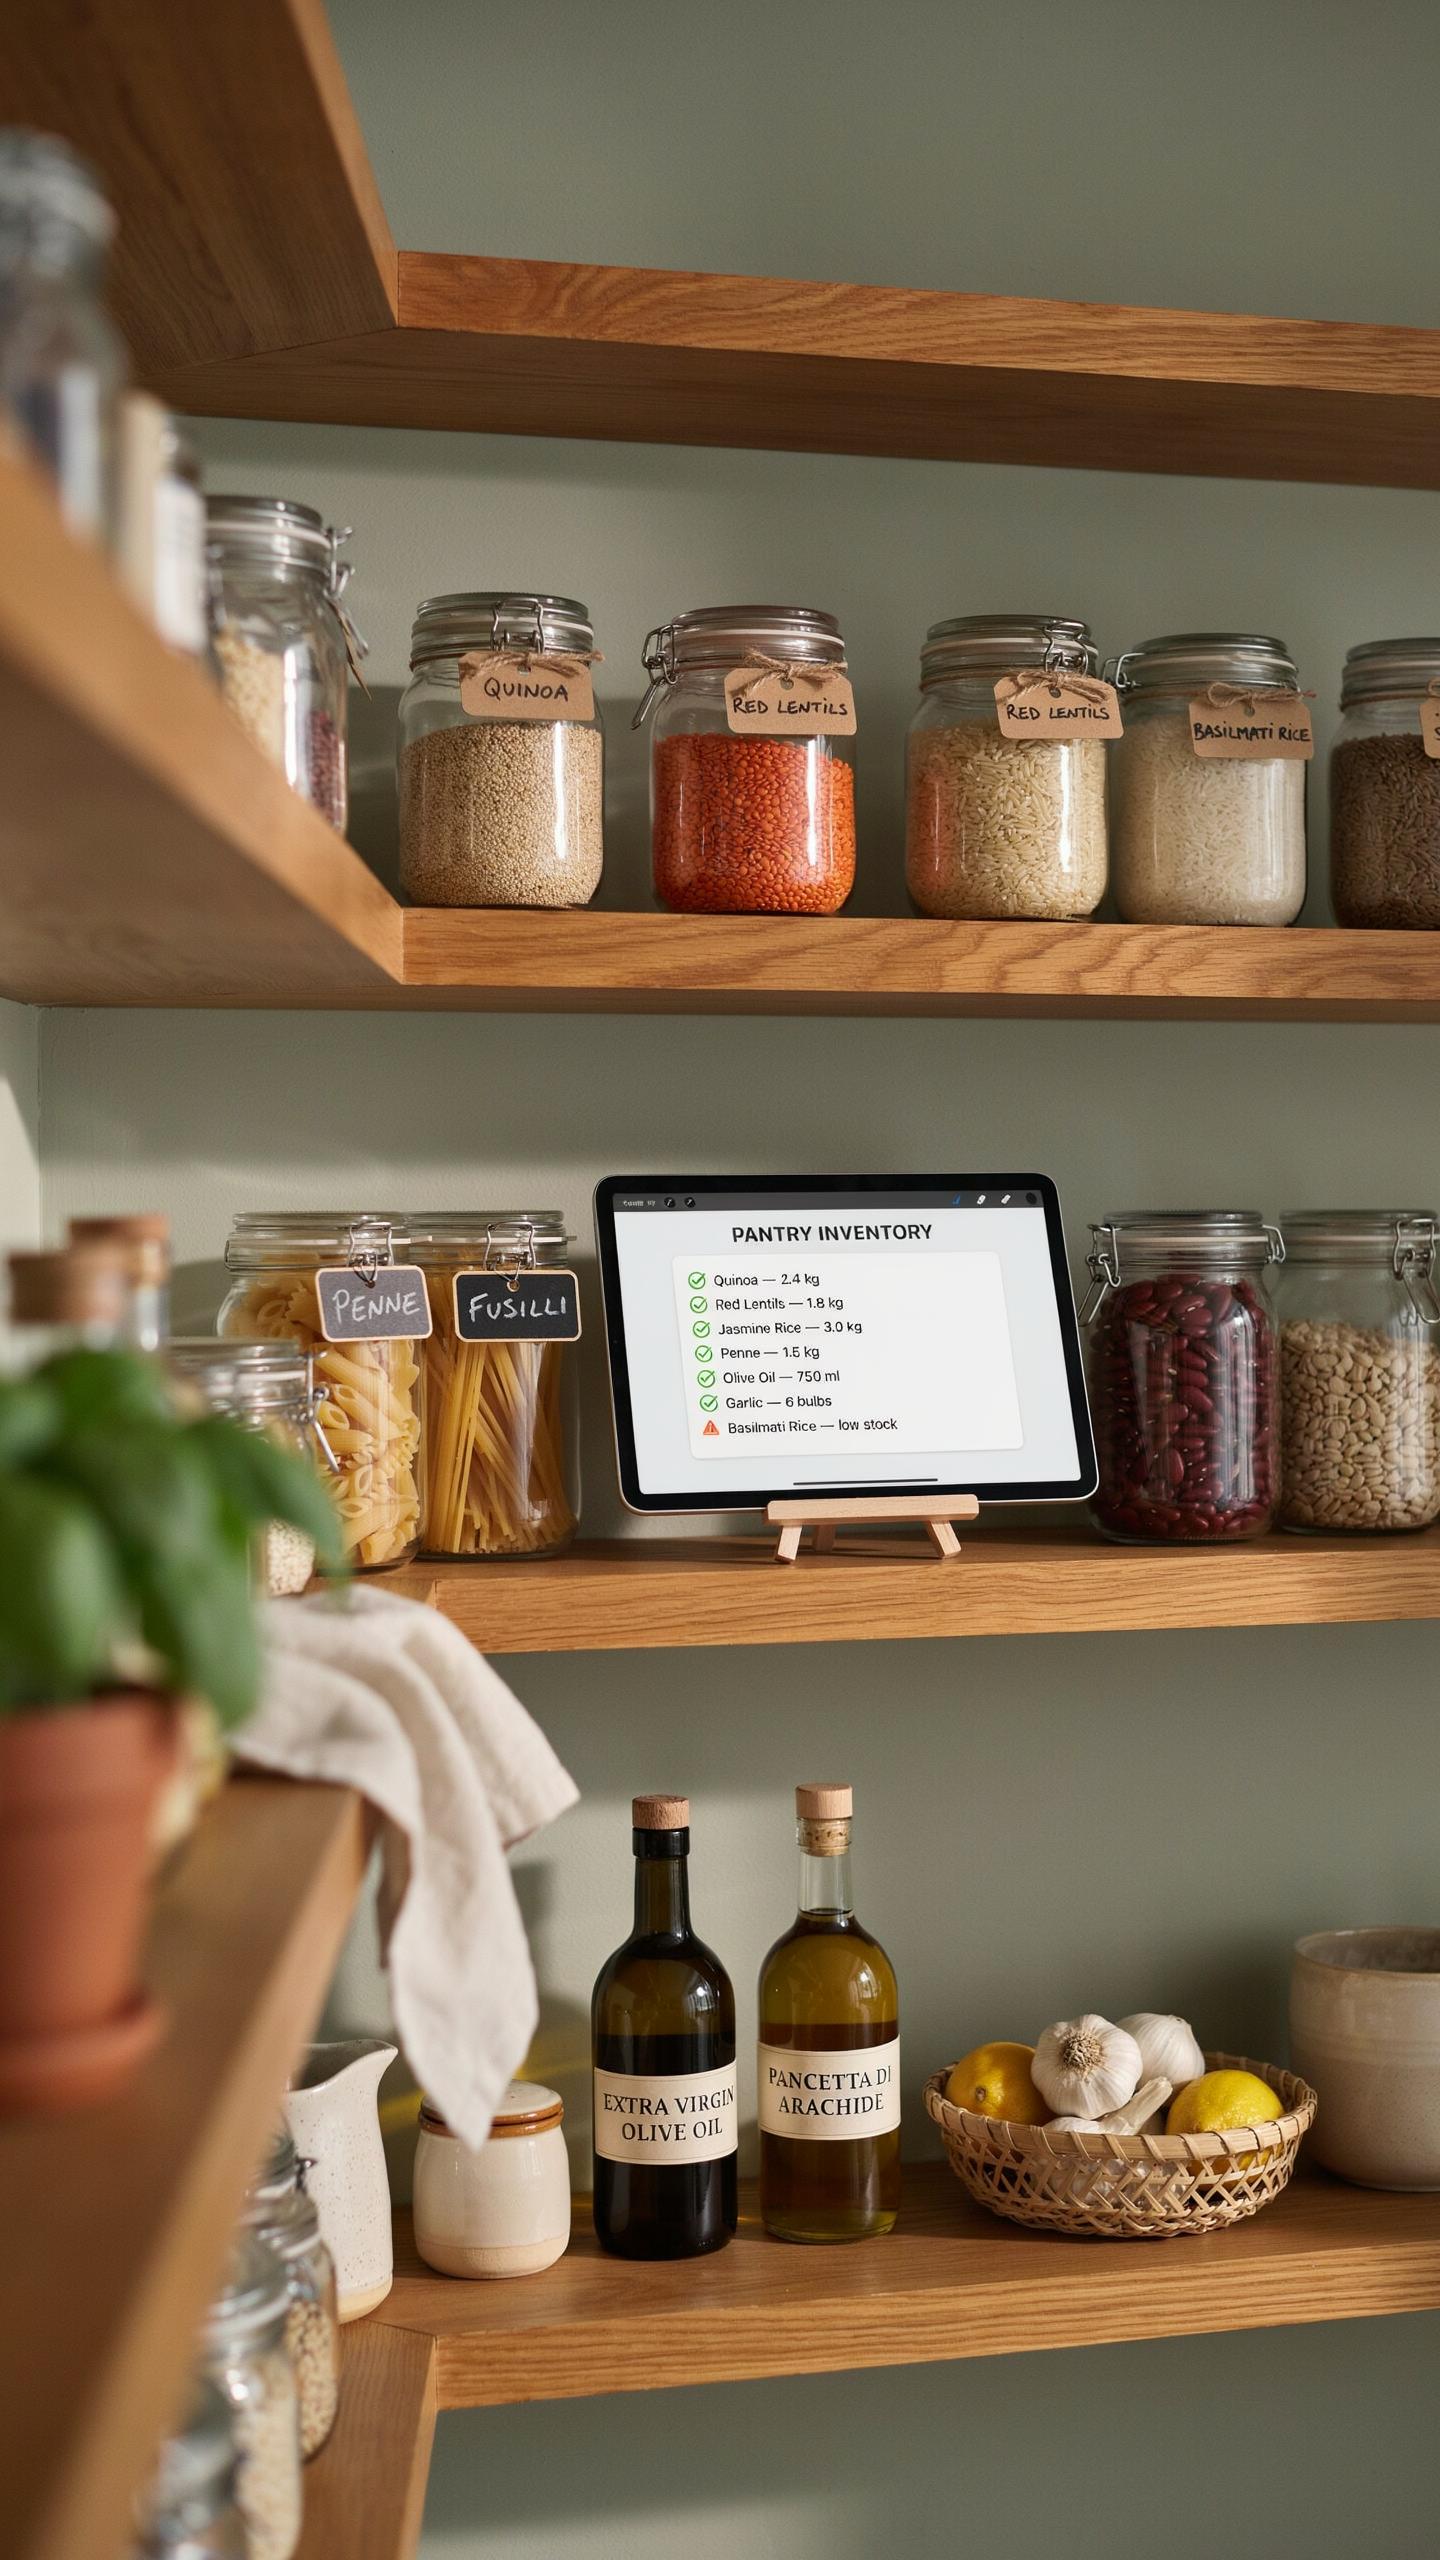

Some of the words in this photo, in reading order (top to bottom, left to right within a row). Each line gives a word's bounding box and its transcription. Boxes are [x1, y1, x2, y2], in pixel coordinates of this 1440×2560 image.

[484, 677, 569, 702] QUINOA
[733, 697, 768, 714] RED
[1006, 703, 1040, 720] RED
[732, 1226, 812, 1243] PANTRY
[819, 1224, 933, 1242] INVENTORY
[714, 1274, 758, 1287] Quinoa
[781, 1274, 801, 1285] 2.4
[805, 1273, 820, 1287] kg
[332, 1289, 421, 1324] PENNE
[469, 1292, 567, 1323] FUSILLI
[715, 1298, 740, 1310] Red
[744, 1297, 786, 1310] Lentils
[806, 1298, 825, 1309] 1.8
[828, 1297, 844, 1310] kg
[718, 1322, 771, 1336] Jasmine
[775, 1321, 801, 1334] Rice
[823, 1321, 843, 1333] 3.0
[847, 1321, 863, 1335] kg
[720, 1347, 760, 1359] Penne
[782, 1346, 800, 1358] 1.5
[804, 1346, 820, 1360] kg
[723, 1371, 755, 1384] Olive
[758, 1371, 776, 1383] Oil
[797, 1371, 821, 1382] 750
[824, 1370, 840, 1382] ml
[726, 1396, 763, 1409] Garlic
[785, 1396, 794, 1407] 6
[797, 1395, 832, 1407] bulbs
[728, 1420, 786, 1434] Basilmati
[789, 1420, 817, 1432] Rice
[838, 1419, 859, 1431] low
[863, 1418, 898, 1430] stock
[769, 2067, 872, 2090] PANCETTA
[876, 2065, 891, 2086] DI
[603, 2093, 669, 2115] EXTRA
[674, 2085, 734, 2114] VIRGIN
[779, 2093, 884, 2116] ARACHIDE
[622, 2122, 687, 2142] OLIVE
[693, 2118, 723, 2139] OIL
